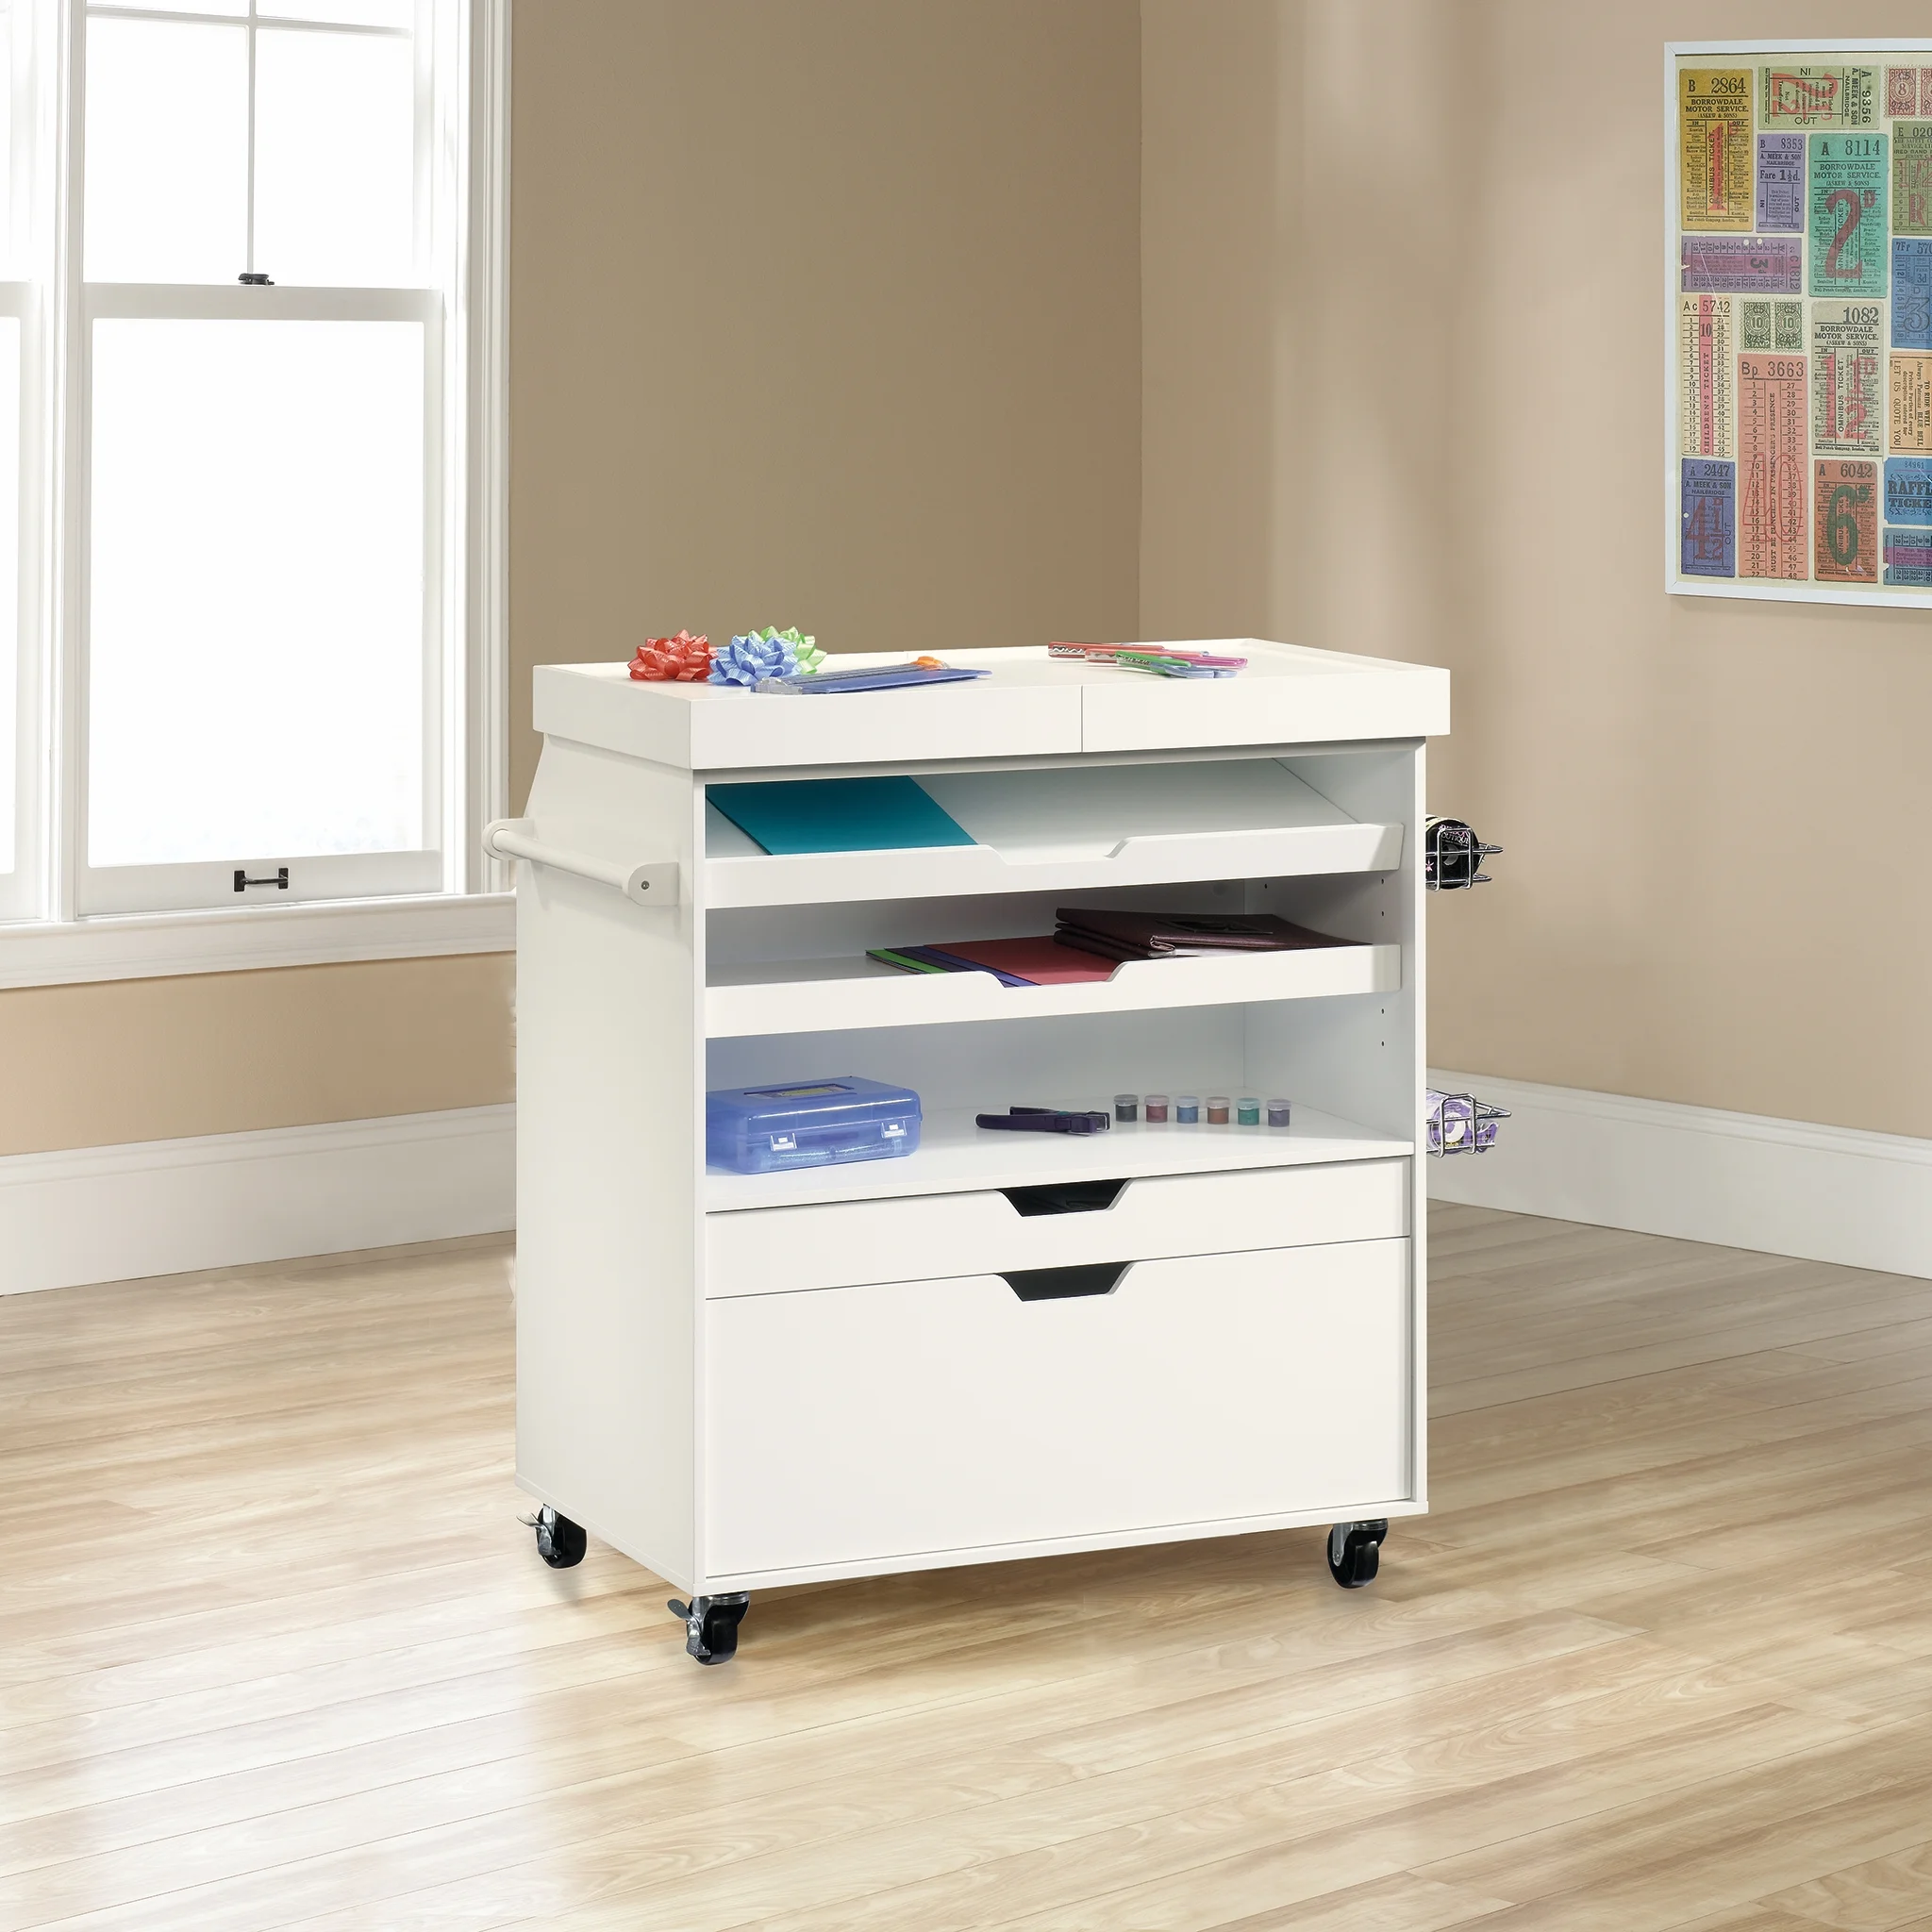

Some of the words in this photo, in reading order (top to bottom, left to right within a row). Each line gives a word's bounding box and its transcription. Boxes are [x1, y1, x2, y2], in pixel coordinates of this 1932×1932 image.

[1689, 79, 1696, 92] B
[1711, 77, 1746, 93] 2864
[1899, 83, 1907, 95] 8
[1862, 90, 1872, 124] 9356
[1898, 127, 1904, 136] E
[1760, 140, 1766, 148] B
[1781, 138, 1803, 150] 8353
[1821, 142, 1830, 156] A
[1845, 140, 1880, 156] 8114
[1760, 170, 1775, 179] Fare
[1825, 190, 1863, 278] 2
[1790, 266, 1801, 290] 1812
[1917, 274, 1926, 283] 3d
[1703, 300, 1730, 313] 5742
[1843, 307, 1879, 325] 1082
[1701, 323, 1711, 337] 10
[1741, 361, 1758, 378] Bp
[1768, 361, 1804, 377] 3663
[1893, 382, 1901, 391] US
[1924, 381, 1930, 390] TO
[1705, 463, 1729, 476] 2447
[1819, 464, 1826, 475] A
[1840, 463, 1873, 478] 6042
[1771, 486, 1775, 495] IN
[1771, 538, 1776, 547] BE
[1440, 830, 1469, 844] OUTIQUE
